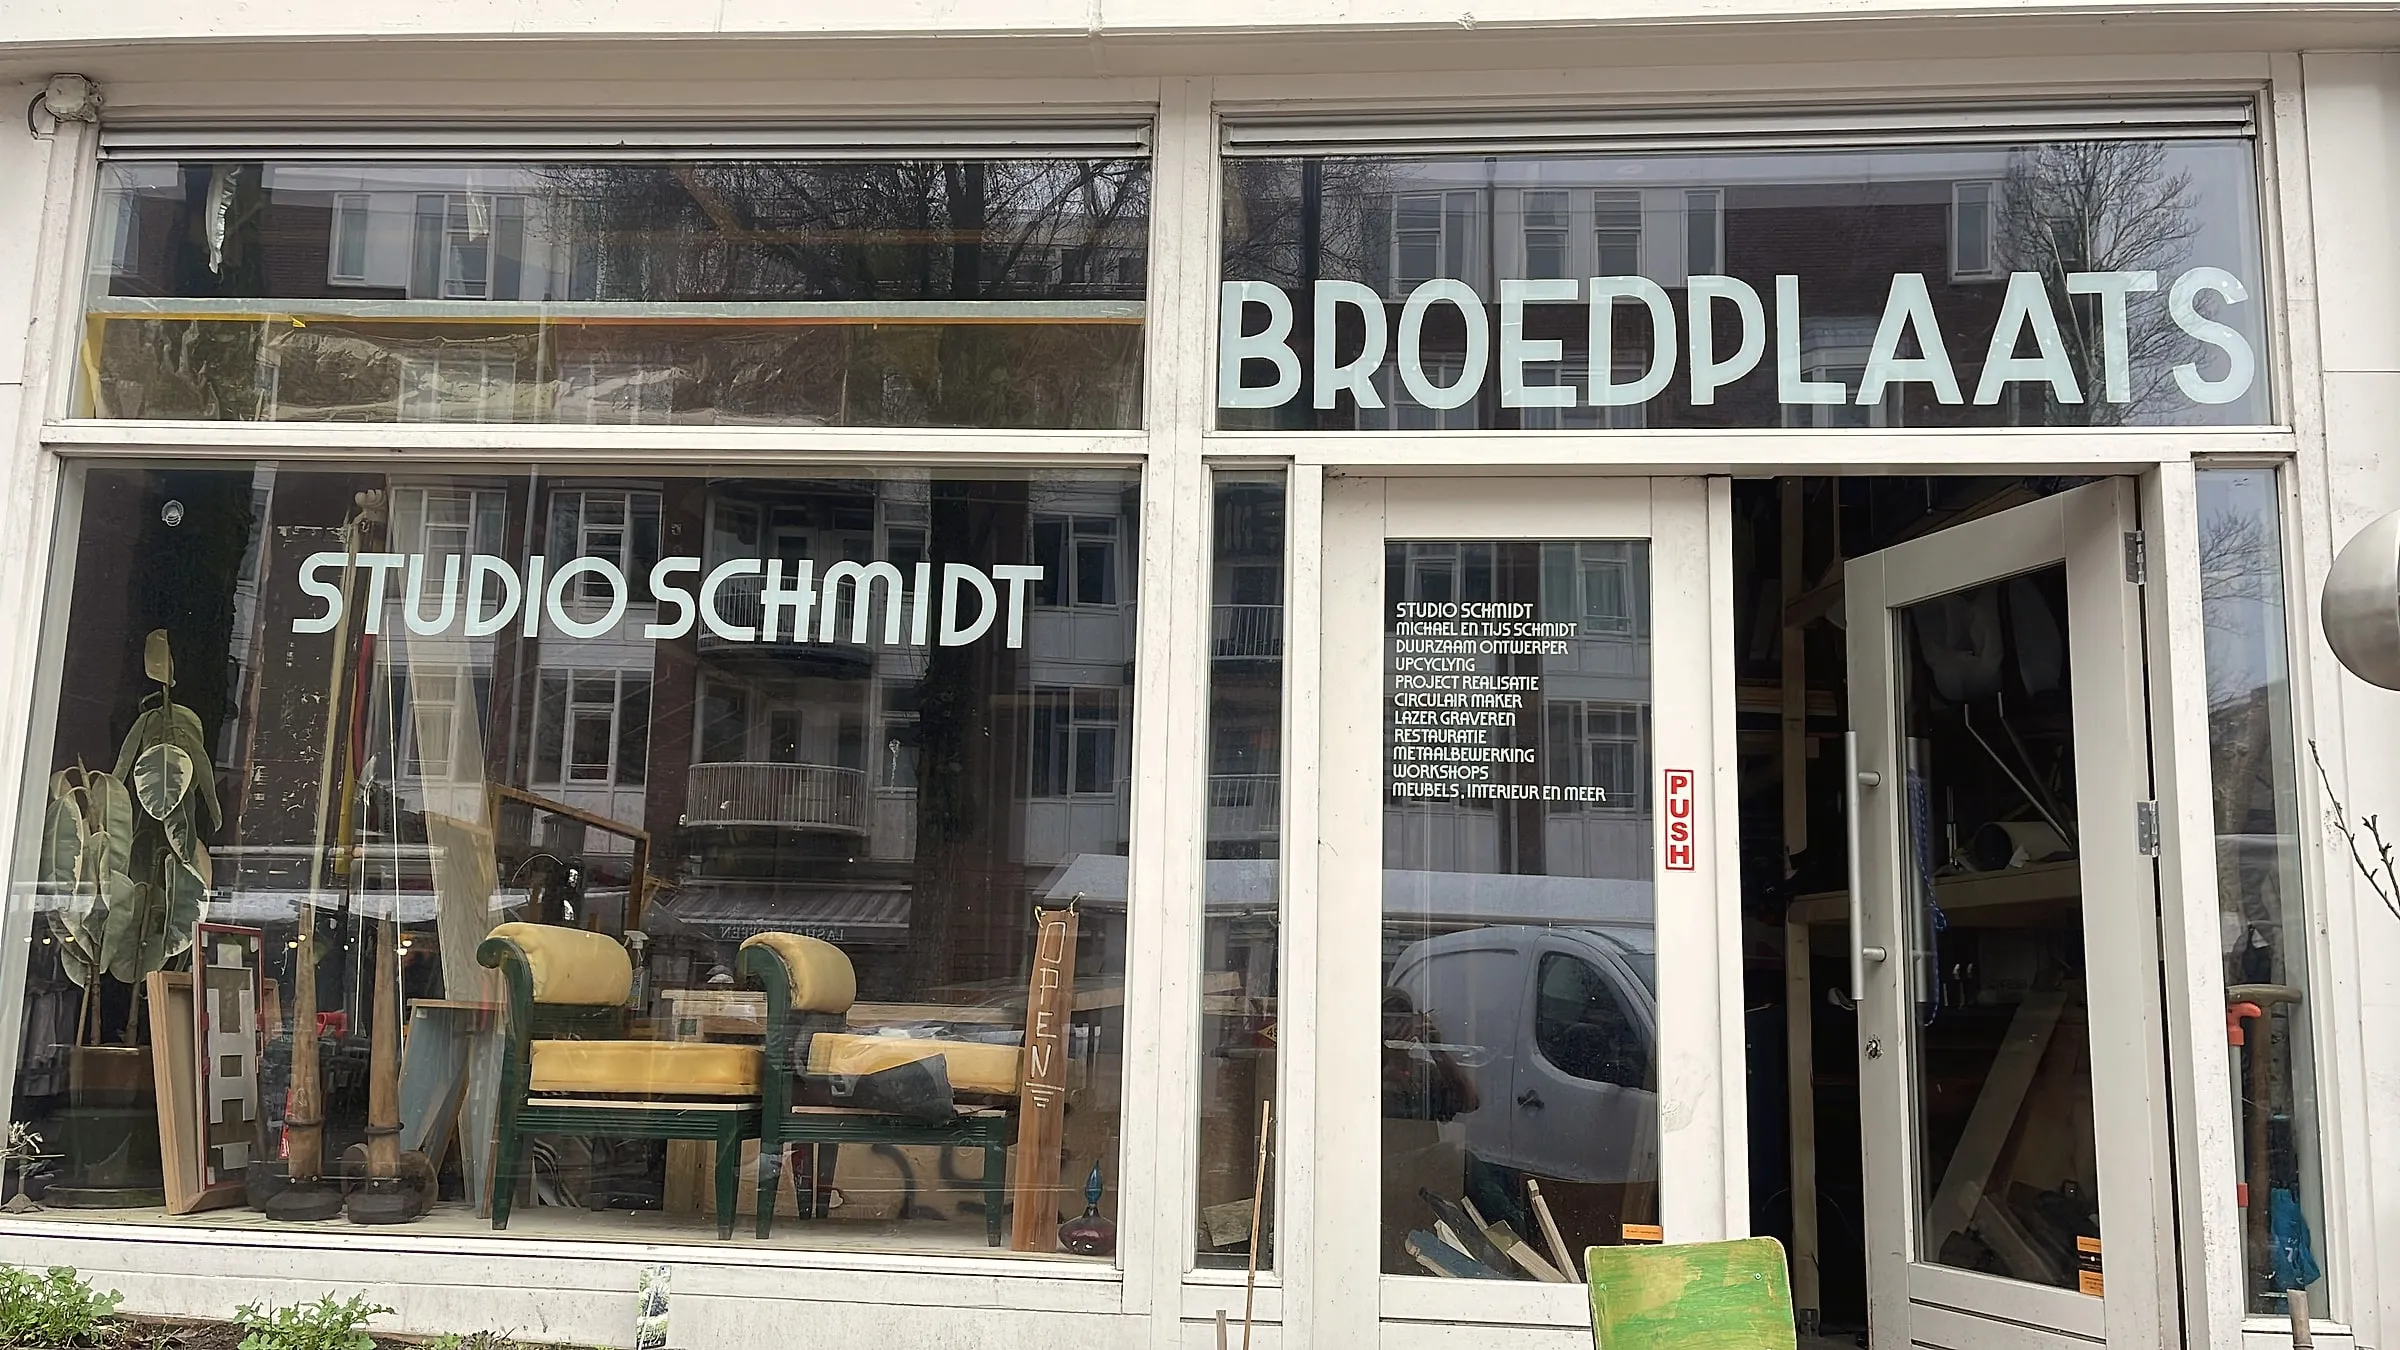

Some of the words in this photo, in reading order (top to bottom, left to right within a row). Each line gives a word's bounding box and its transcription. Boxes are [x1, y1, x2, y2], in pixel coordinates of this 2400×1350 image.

[1217, 265, 2255, 410] BROEDPLAATS
[292, 551, 629, 640] STUDIO
[643, 556, 1044, 650] SCHMIDT
[1396, 602, 1458, 618] STUDIO
[1460, 602, 1534, 619] SCHMIDT
[1396, 621, 1458, 636] MICHAEL
[1460, 621, 1479, 636] EN
[1480, 621, 1511, 637] TIJS
[1513, 622, 1578, 637] SCHMIDT
[1396, 639, 1477, 654] DUURZAAM
[1479, 640, 1569, 655] ONTWERPER
[1395, 675, 1459, 689] PROJECT
[1462, 675, 1539, 691] REALISATIE
[1394, 692, 1469, 707] CIRCULAIR
[1470, 693, 1523, 709] MAKER
[1394, 710, 1438, 725] LAZER
[1440, 711, 1516, 727] GRAVEREN
[1394, 728, 1487, 744] RESTAURATIE
[1393, 746, 1535, 763] METAALBEWERKING
[1392, 764, 1489, 780] WORKSHOPS
[1467, 783, 1541, 799] INTERIEUR
[1542, 785, 1561, 800] EN
[1564, 786, 1607, 802] MEER
[1670, 775, 1689, 865] PUSH
[1030, 921, 1067, 1078] OPEN
